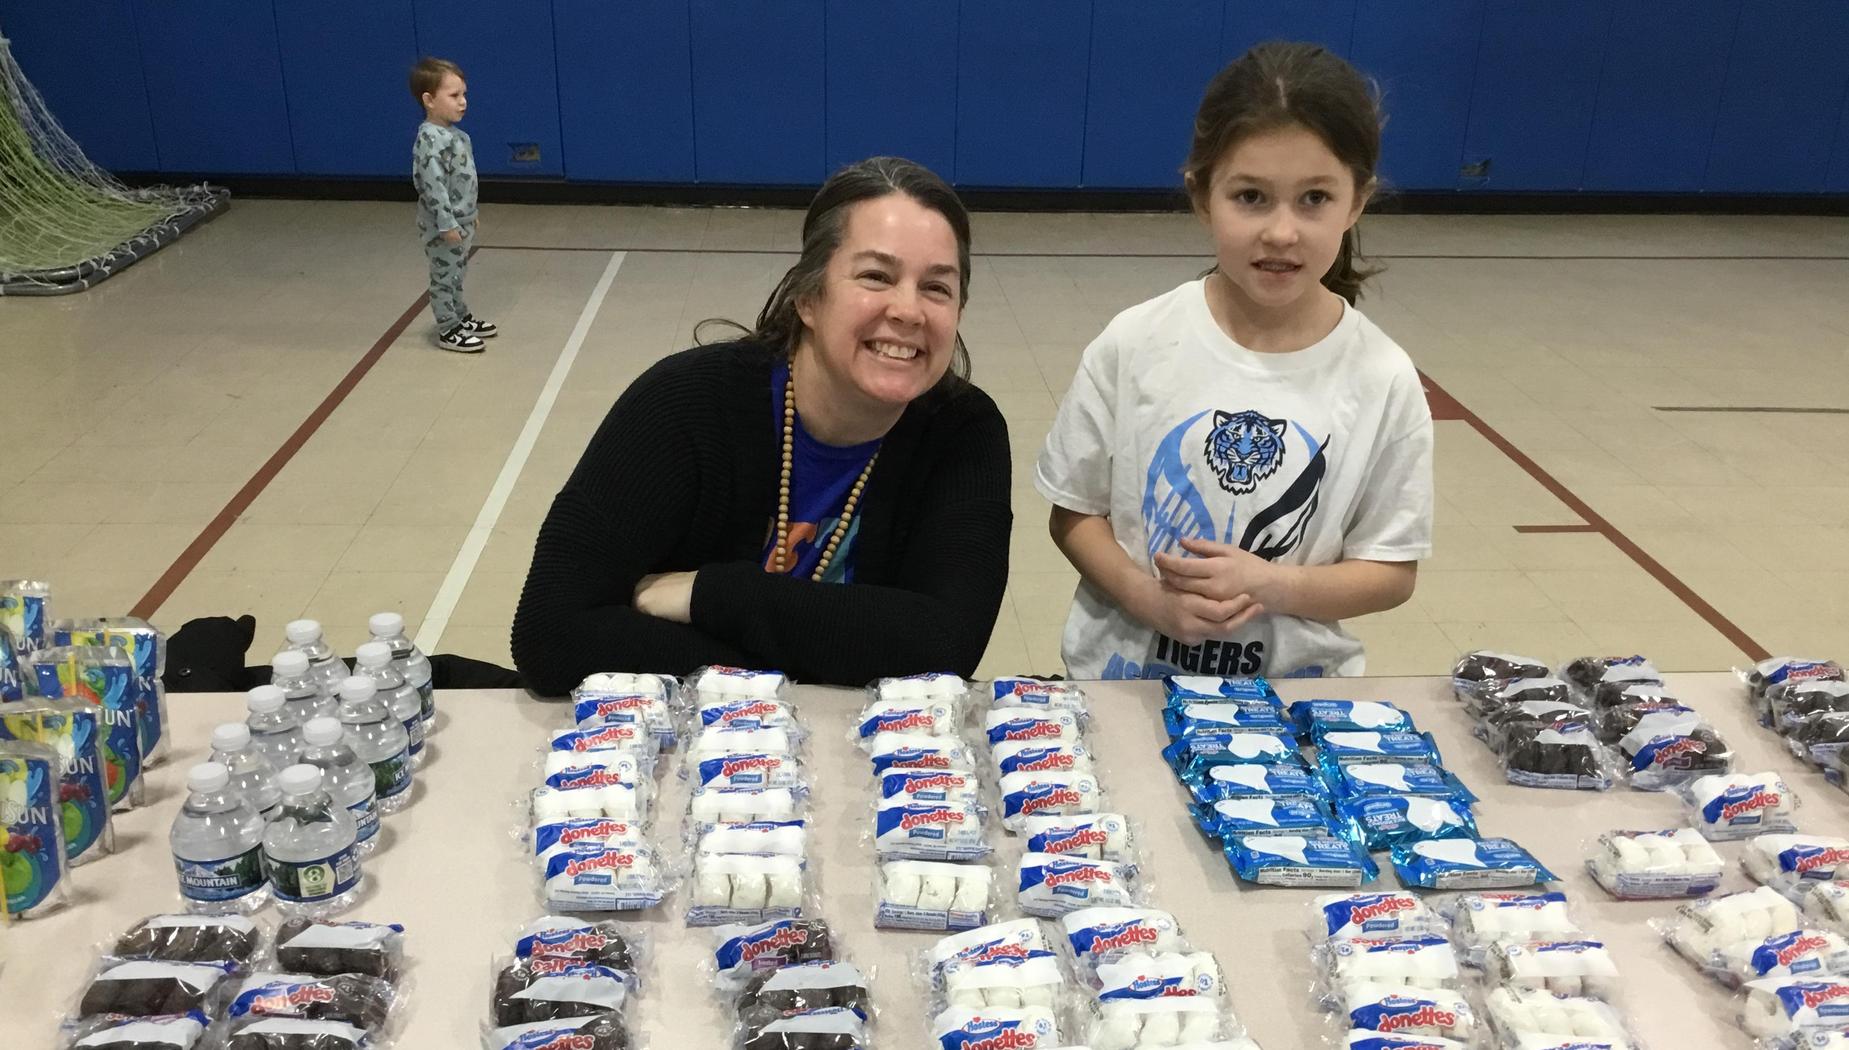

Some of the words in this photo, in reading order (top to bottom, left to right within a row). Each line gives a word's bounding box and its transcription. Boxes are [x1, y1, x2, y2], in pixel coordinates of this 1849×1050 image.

[17, 637, 40, 652] UN
[1156, 635, 1264, 676] TIGERS
[598, 697, 654, 717] donettes
[722, 702, 778, 721] donettes
[104, 709, 132, 728] UN
[878, 714, 933, 731] donettes
[575, 728, 634, 752] donettes
[1006, 723, 1061, 740] donettes
[722, 759, 782, 777] donettes
[1017, 753, 1073, 771] donettes
[905, 775, 965, 793] donettes
[1021, 790, 1080, 815] donettes
[1723, 792, 1779, 820] donettes
[901, 810, 964, 830] donettes
[1366, 812, 1402, 823] TREATS
[560, 822, 627, 844] donettes
[912, 830, 940, 838] Powdered
[1045, 830, 1107, 855] donettes
[566, 852, 634, 876] donettes
[186, 876, 238, 888] MOUNTAIN
[1045, 867, 1112, 887] donettes
[1351, 898, 1415, 925] donettes
[532, 934, 607, 956] donettes
[742, 927, 807, 961] donettes
[1092, 926, 1157, 955] donettes
[1134, 978, 1161, 990] Hostess
[968, 1020, 998, 1031] Hostess
[1379, 1006, 1455, 1032] donettes
